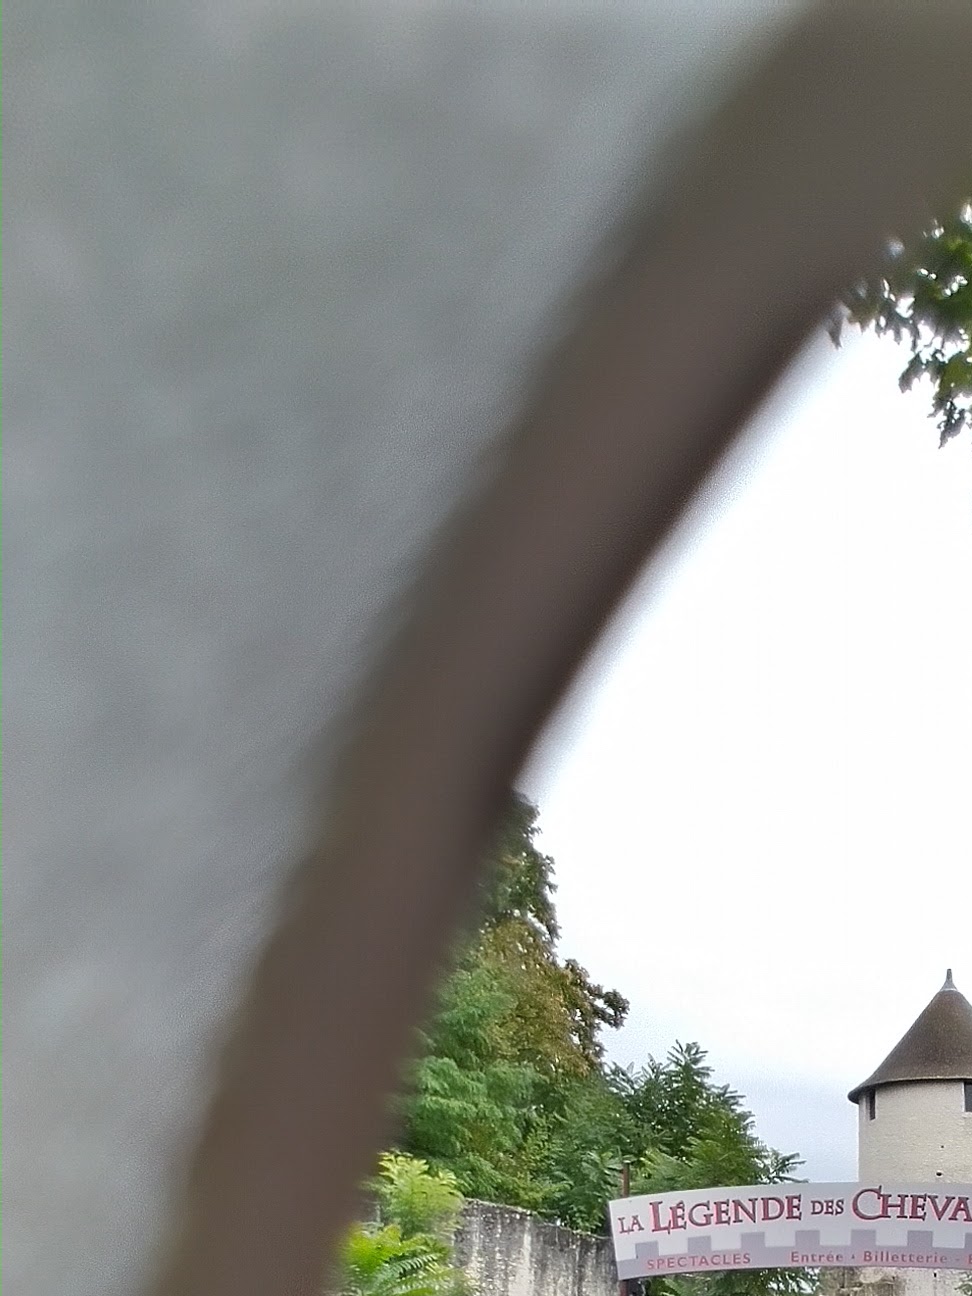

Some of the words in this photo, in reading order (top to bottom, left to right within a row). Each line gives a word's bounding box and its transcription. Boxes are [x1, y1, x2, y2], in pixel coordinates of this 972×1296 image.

[618, 1214, 644, 1235] LA
[649, 1193, 803, 1235] LÉGENDE
[810, 1199, 844, 1216] DES
[646, 1252, 752, 1270] SPECTACLES
[790, 1250, 845, 1264] Entrée
[863, 1249, 948, 1265] Billetterie
